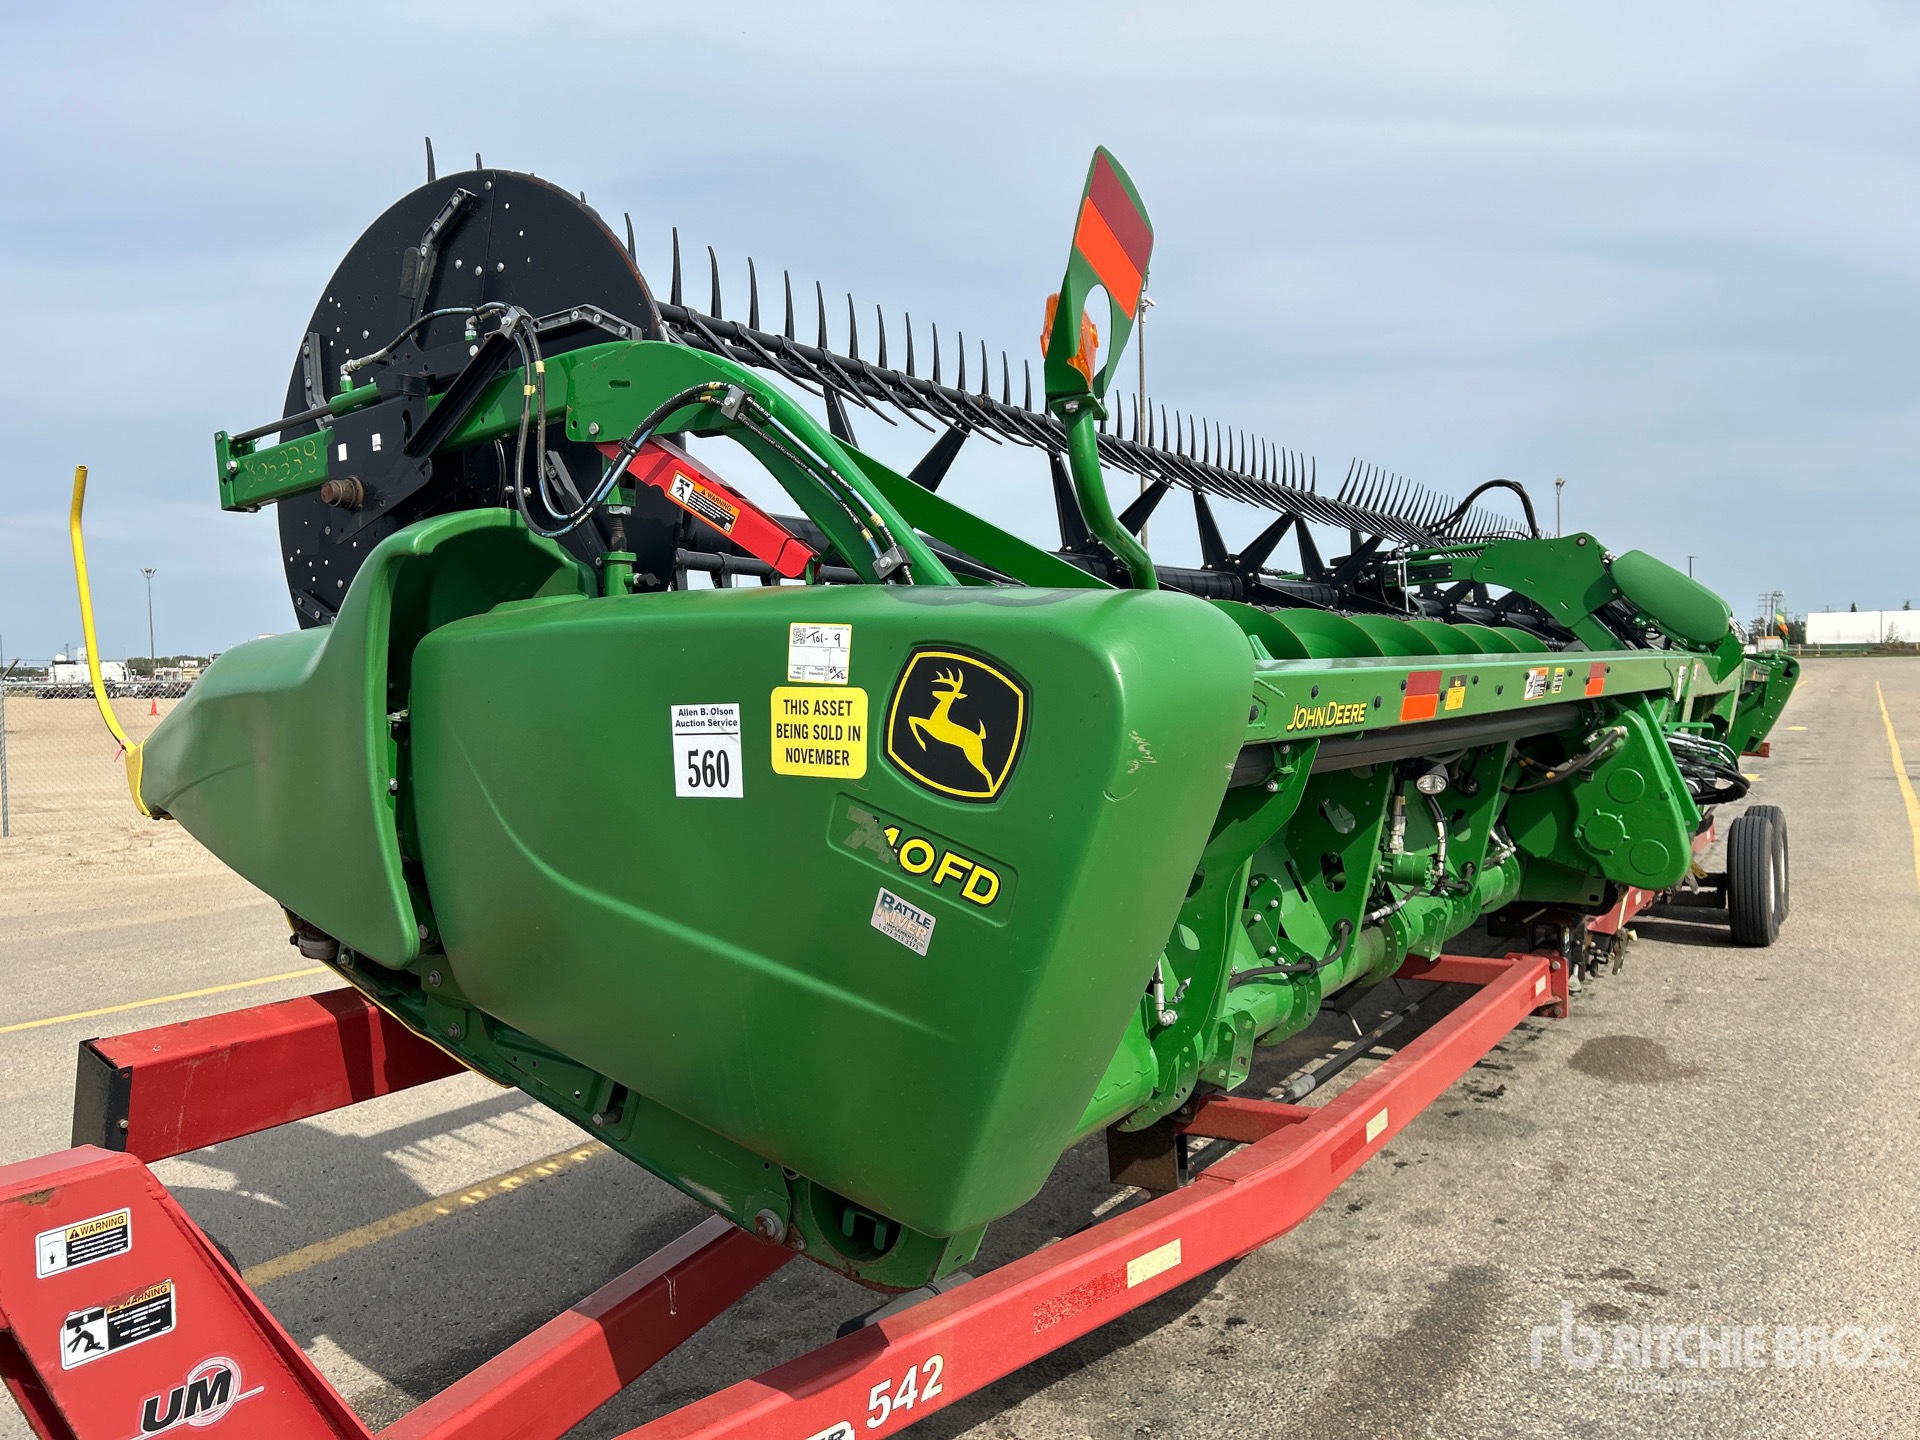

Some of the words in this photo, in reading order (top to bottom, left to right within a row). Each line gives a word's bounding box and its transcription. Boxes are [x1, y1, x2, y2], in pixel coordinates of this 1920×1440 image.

[707, 492, 732, 512] WARNING
[678, 708, 698, 717] Allen
[700, 707, 709, 716] B.
[710, 707, 734, 716] Olson
[783, 699, 809, 716] THIS
[813, 700, 853, 717] ASSET
[675, 719, 706, 728] Auction
[707, 718, 738, 727] Service
[776, 723, 809, 740] BEING
[813, 724, 843, 741] SOLD
[848, 725, 861, 742] IN
[786, 747, 850, 767] NOVEMBER
[688, 749, 730, 788] 560
[880, 892, 931, 930] BATTLE
[80, 1215, 124, 1236] WARNING
[142, 1368, 232, 1432] UM
[866, 1354, 944, 1429] 542
